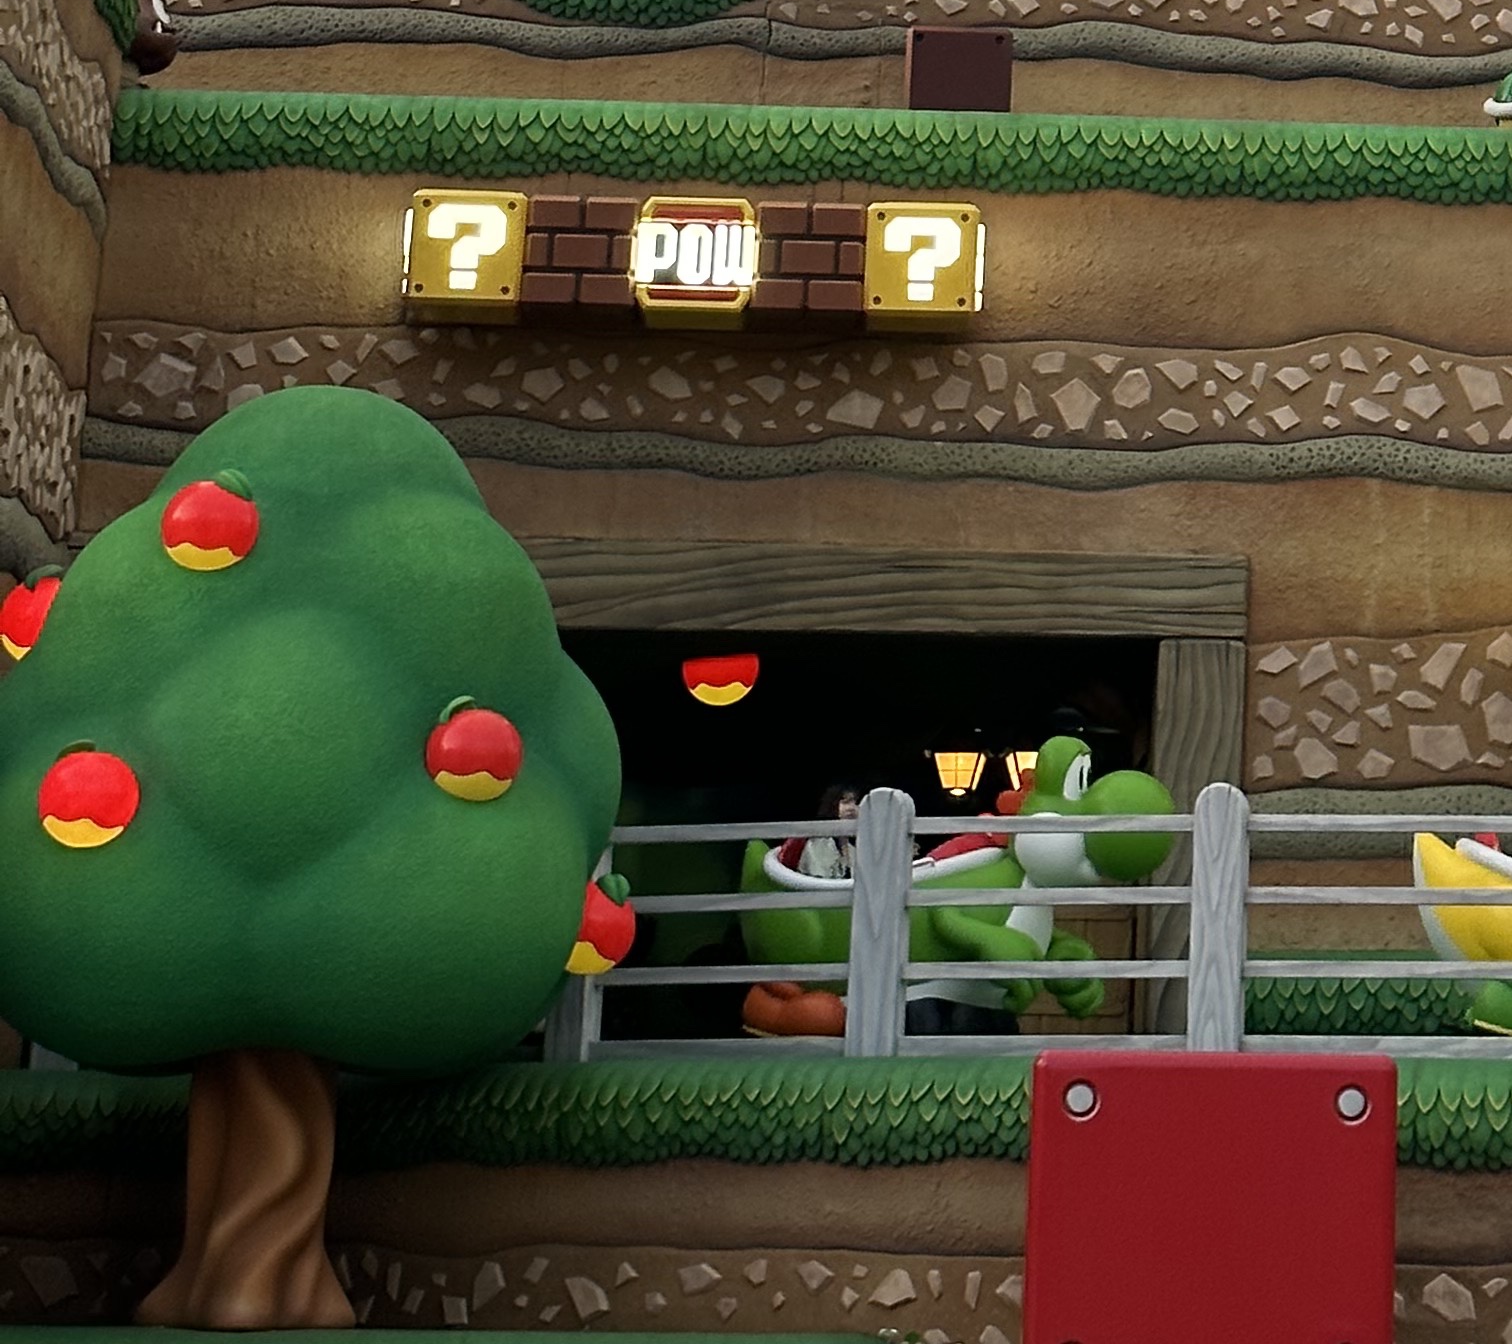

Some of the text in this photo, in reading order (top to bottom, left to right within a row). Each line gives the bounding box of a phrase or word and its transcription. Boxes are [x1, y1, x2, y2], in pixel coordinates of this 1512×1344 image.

[427, 204, 506, 290] ?
[636, 223, 756, 286] POW
[884, 217, 962, 300] ?
